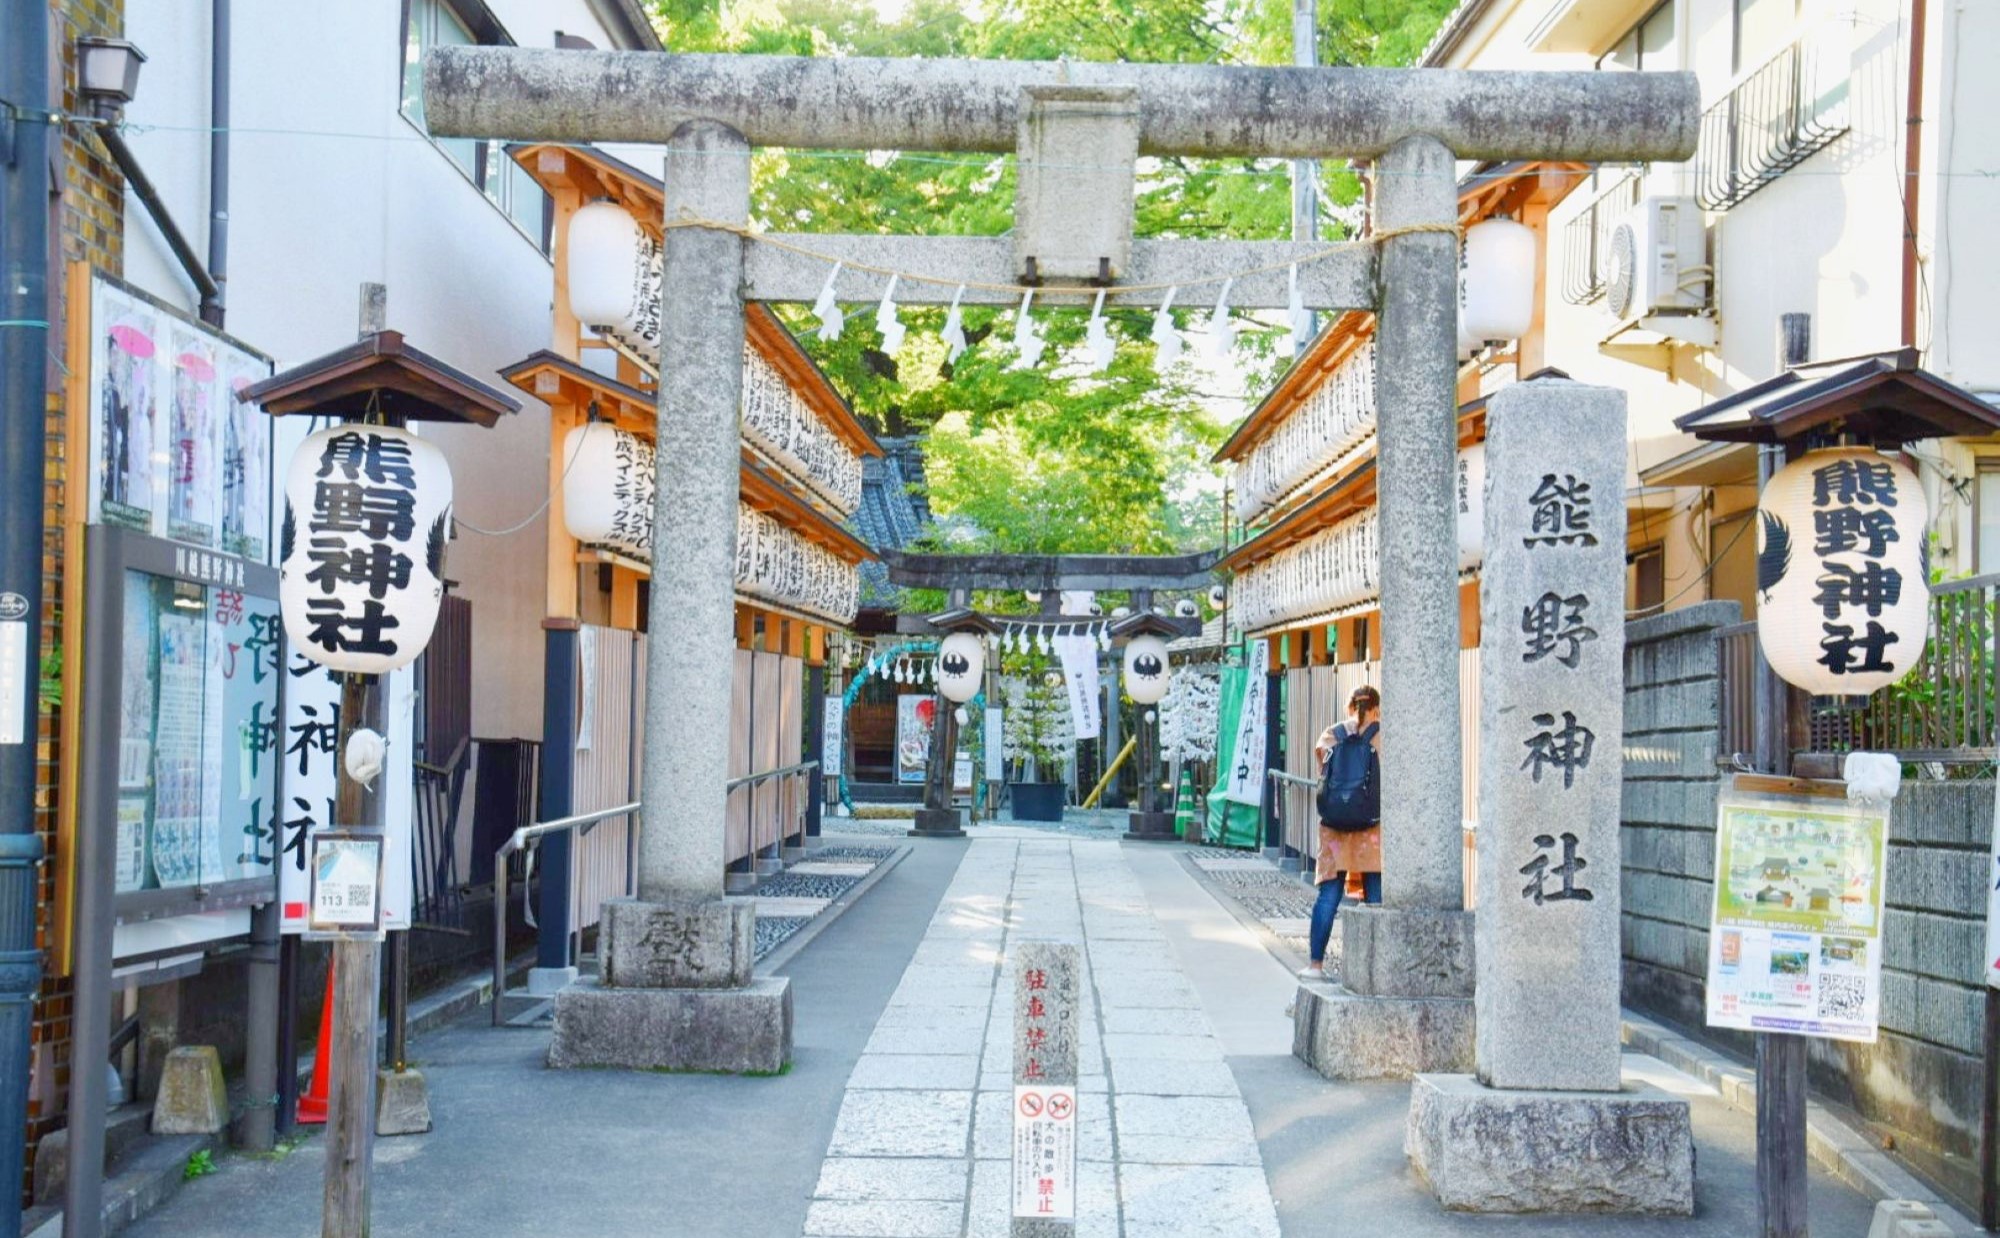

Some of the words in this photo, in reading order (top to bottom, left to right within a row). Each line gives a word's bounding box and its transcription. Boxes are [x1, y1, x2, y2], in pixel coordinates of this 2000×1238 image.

[175, 547, 245, 588] 川越熊野神社
[306, 431, 417, 657] 熊野神社
[1812, 459, 1902, 675] 熊野神社
[1519, 473, 1599, 904] 熊野神社
[321, 896, 342, 906] 113
[1023, 968, 1047, 1079] 駐車禁止
[1038, 1178, 1055, 1213] 禁止
